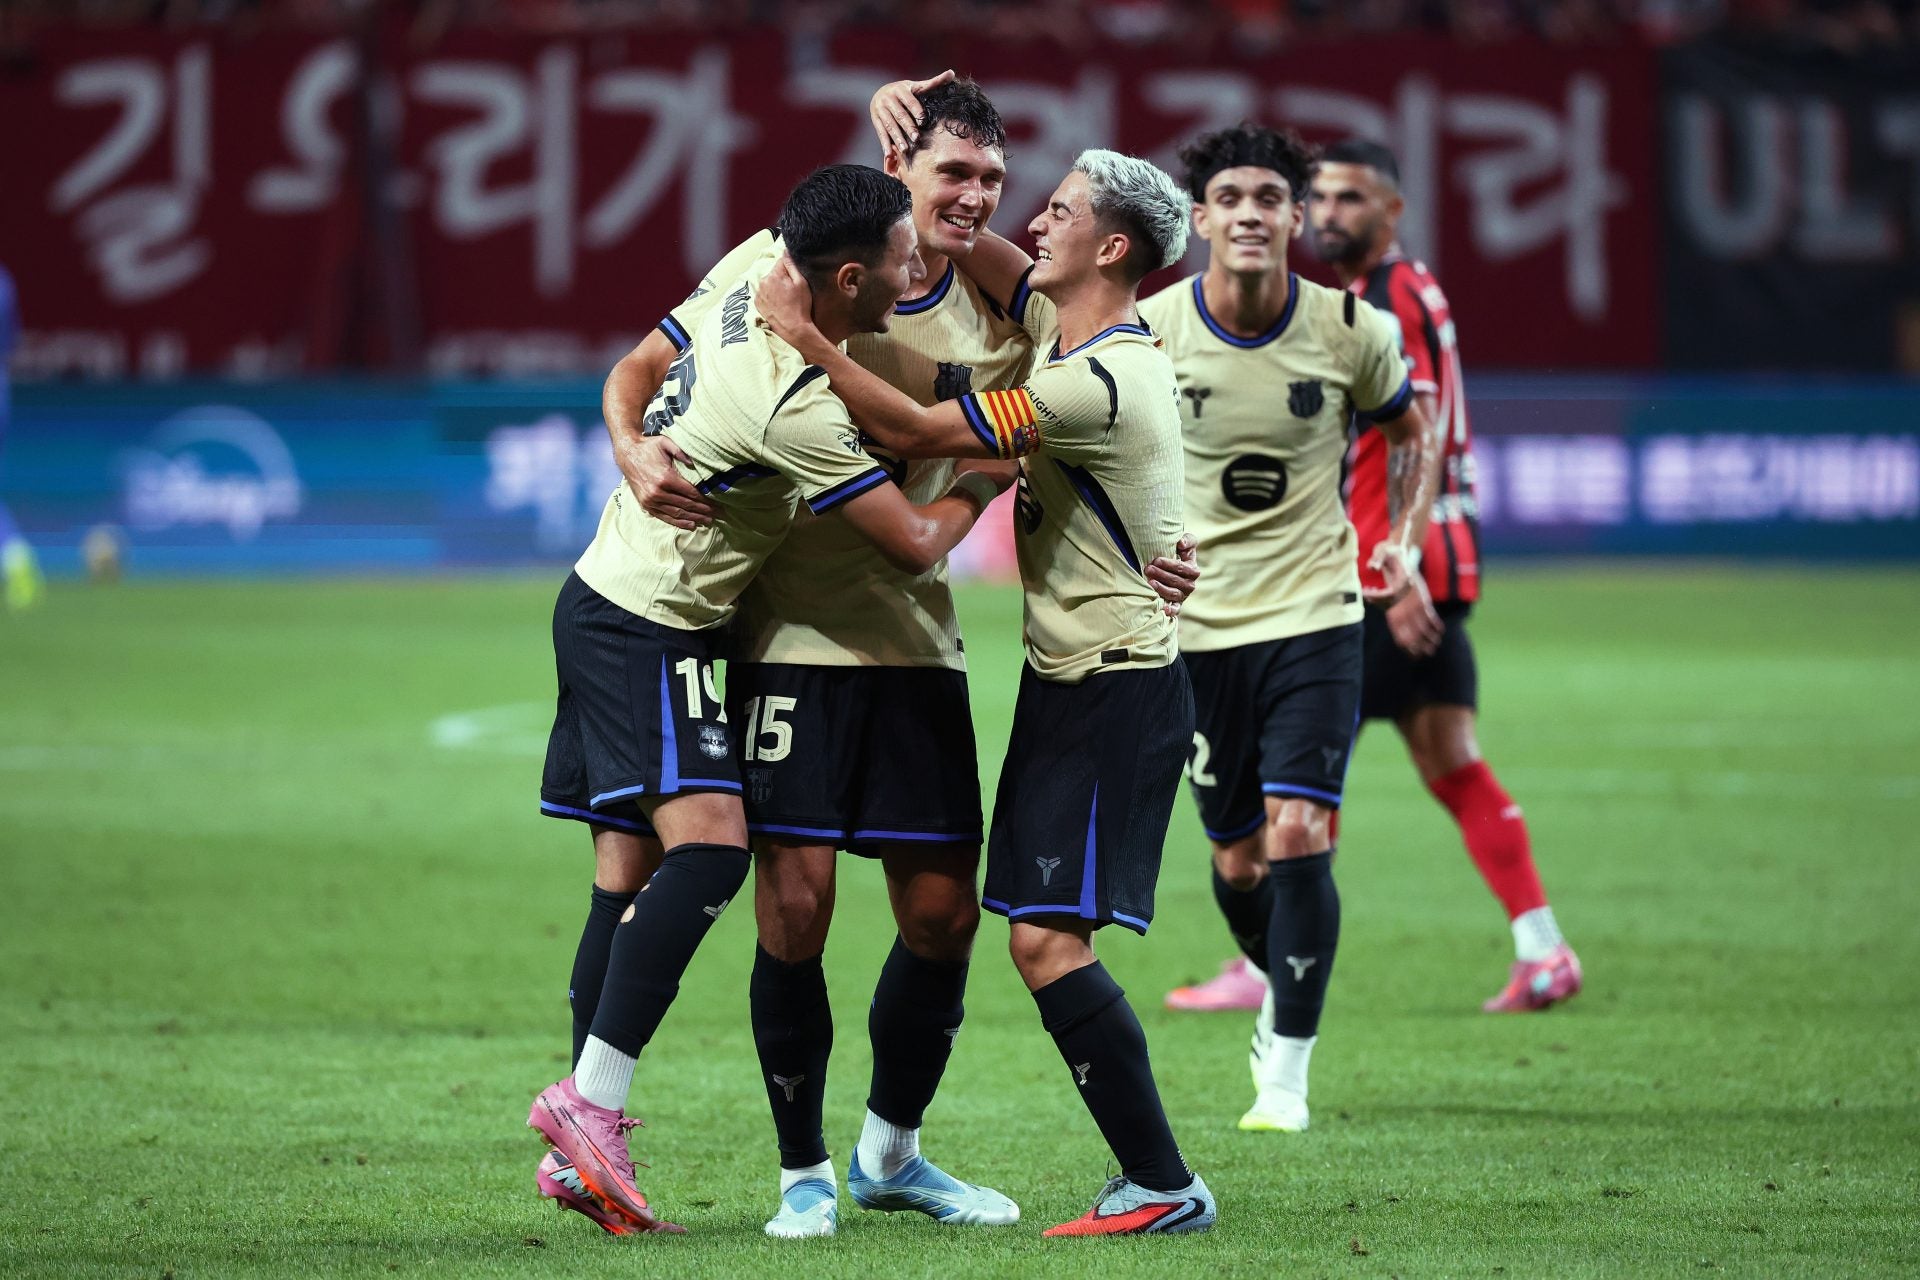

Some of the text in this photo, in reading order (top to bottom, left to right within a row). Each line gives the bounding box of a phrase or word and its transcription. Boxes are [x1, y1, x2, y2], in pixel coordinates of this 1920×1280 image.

[48, 42, 212, 302] 길
[744, 695, 797, 762] 15
[1184, 730, 1217, 787] 2
